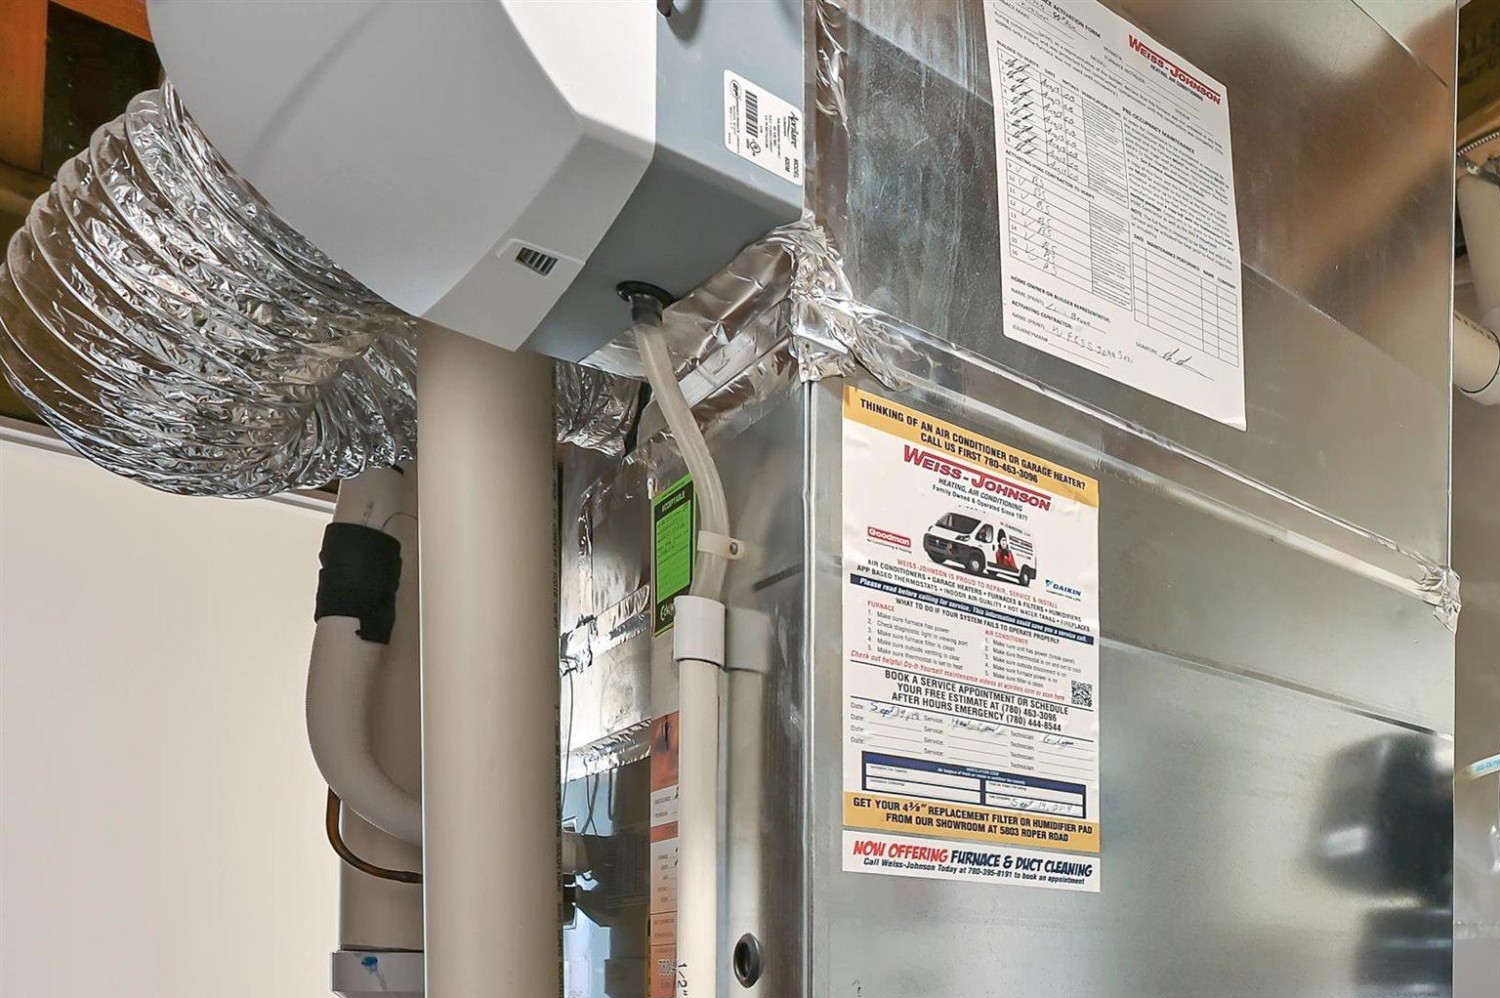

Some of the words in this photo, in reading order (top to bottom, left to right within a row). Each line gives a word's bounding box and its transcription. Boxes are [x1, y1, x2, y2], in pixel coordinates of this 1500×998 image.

[861, 399, 904, 423] THINKING
[907, 416, 918, 428] OF
[921, 421, 933, 434] AN
[936, 427, 950, 440] AIR
[953, 433, 1007, 461] CONDITIONER
[1009, 453, 1019, 466] OR
[1022, 458, 1051, 477] GARAGE
[1054, 470, 1086, 490] HEATER?
[921, 433, 942, 449] CALL
[944, 441, 956, 454] US
[958, 446, 982, 463] FIRST
[984, 455, 1038, 483] 780-463-3096
[939, 478, 967, 493] HEATING,
[968, 488, 979, 497] AIR
[980, 492, 1023, 512] CONDITIONING
[868, 528, 910, 546] Goodman
[1053, 584, 1081, 596] DAIKIN
[885, 670, 910, 684] BOOK
[912, 675, 918, 685] A
[921, 677, 956, 693] SERVICE
[959, 684, 1015, 705] APPOINTMENT
[1018, 696, 1028, 707] OR
[1030, 699, 1068, 715] SCHEDULE
[897, 683, 923, 696] YOUR
[925, 688, 947, 701] FREE
[949, 693, 988, 709] ESTIMATE
[990, 700, 1000, 711] AT
[1001, 703, 1021, 715] (780)
[1023, 707, 1057, 722] 463-3096
[891, 692, 920, 706] AFTER
[923, 698, 953, 712] HOURS
[954, 703, 1004, 721] EMERGENCY
[1006, 713, 1026, 725] (780)
[1028, 717, 1061, 732] 444-8544
[853, 798, 871, 808] GET
[875, 800, 900, 812] YOUR
[928, 806, 989, 822] REPLACEMENT
[992, 814, 1018, 825] FILTER
[1020, 817, 1031, 826] OR
[1033, 818, 1076, 832] HUMIDIFIER
[1078, 823, 1092, 833] PAD
[886, 813, 912, 825] FROM
[915, 817, 933, 827] OUR
[936, 819, 985, 833] SHOWROOM
[988, 825, 997, 834] AT
[1000, 826, 1019, 837] 5803
[1022, 828, 1046, 839] ROPER
[1049, 831, 1068, 842] ROAD
[853, 840, 886, 857] NOW
[889, 842, 948, 863] OFFERING
[951, 850, 1001, 867] FURNACE
[1003, 854, 1012, 869] &
[1015, 856, 1043, 872] DUCT
[1044, 858, 1093, 878] CLEANING
[864, 858, 878, 867] Call
[881, 860, 935, 872] Weiss-Johnson
[937, 864, 957, 876] Today
[959, 866, 966, 875] at
[1014, 871, 1021, 879] to
[1022, 872, 1037, 881] book
[1039, 873, 1046, 882] an
[1048, 874, 1085, 886] appointment
[676, 962, 687, 996] 1/2"
